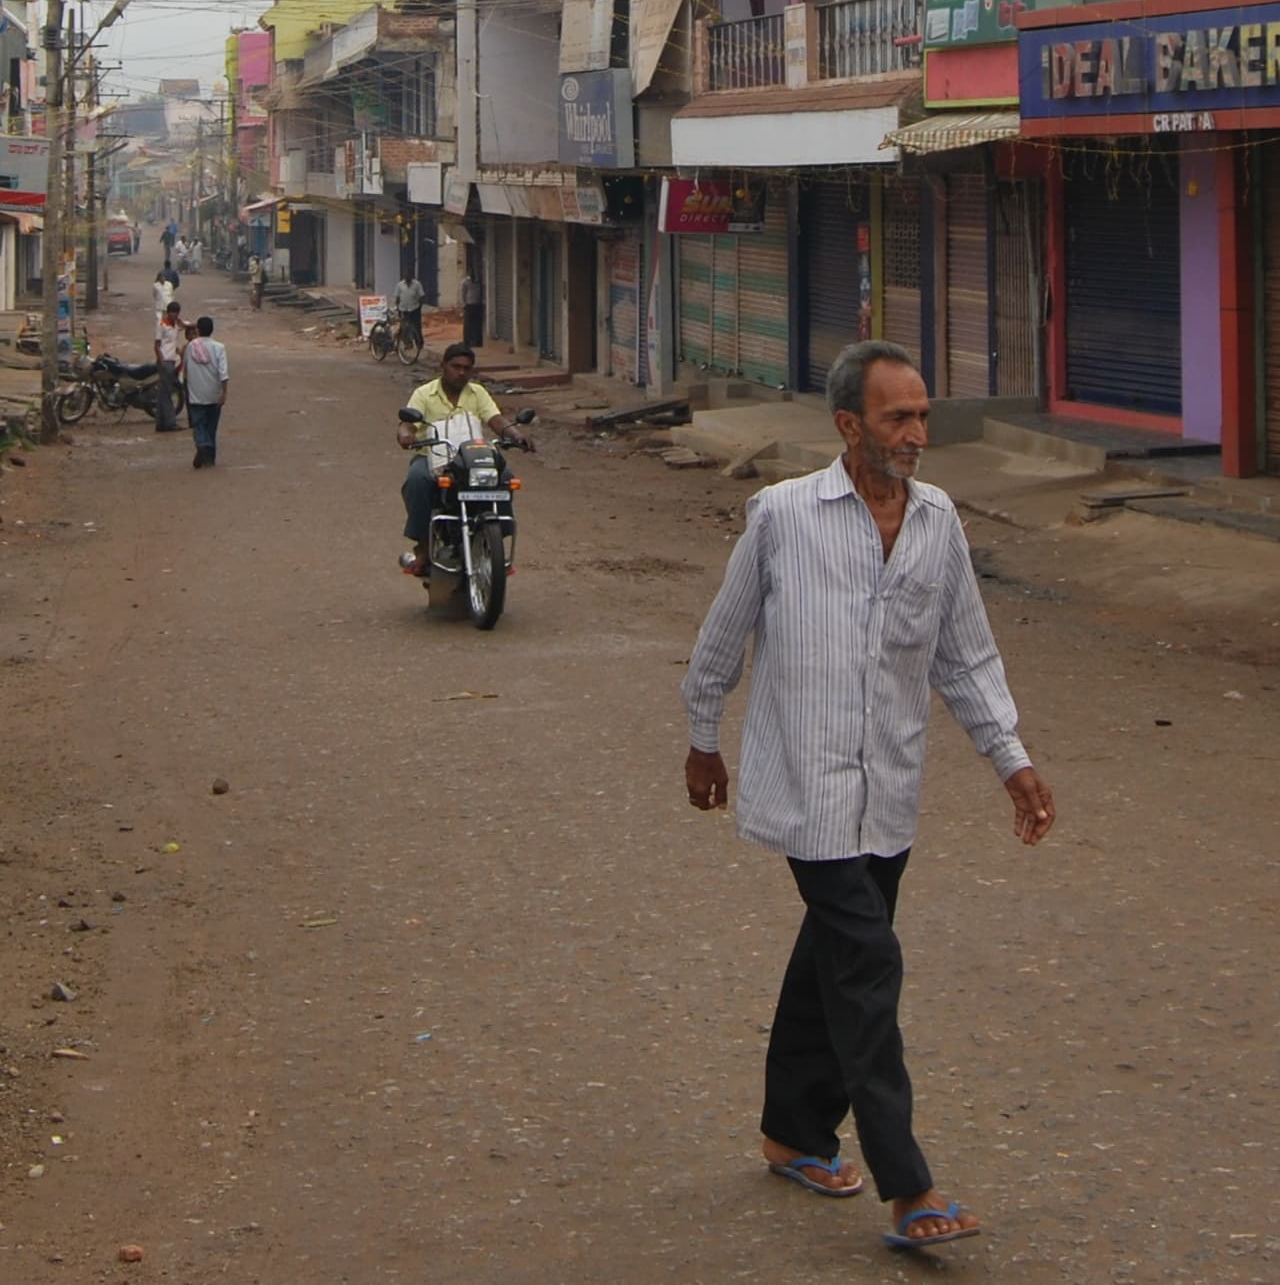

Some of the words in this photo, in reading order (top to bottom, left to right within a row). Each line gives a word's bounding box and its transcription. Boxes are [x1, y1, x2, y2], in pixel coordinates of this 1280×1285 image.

[1041, 36, 1147, 100] IDEAL
[564, 100, 613, 155] Whirlpool
[679, 213, 728, 223] DIRECT
